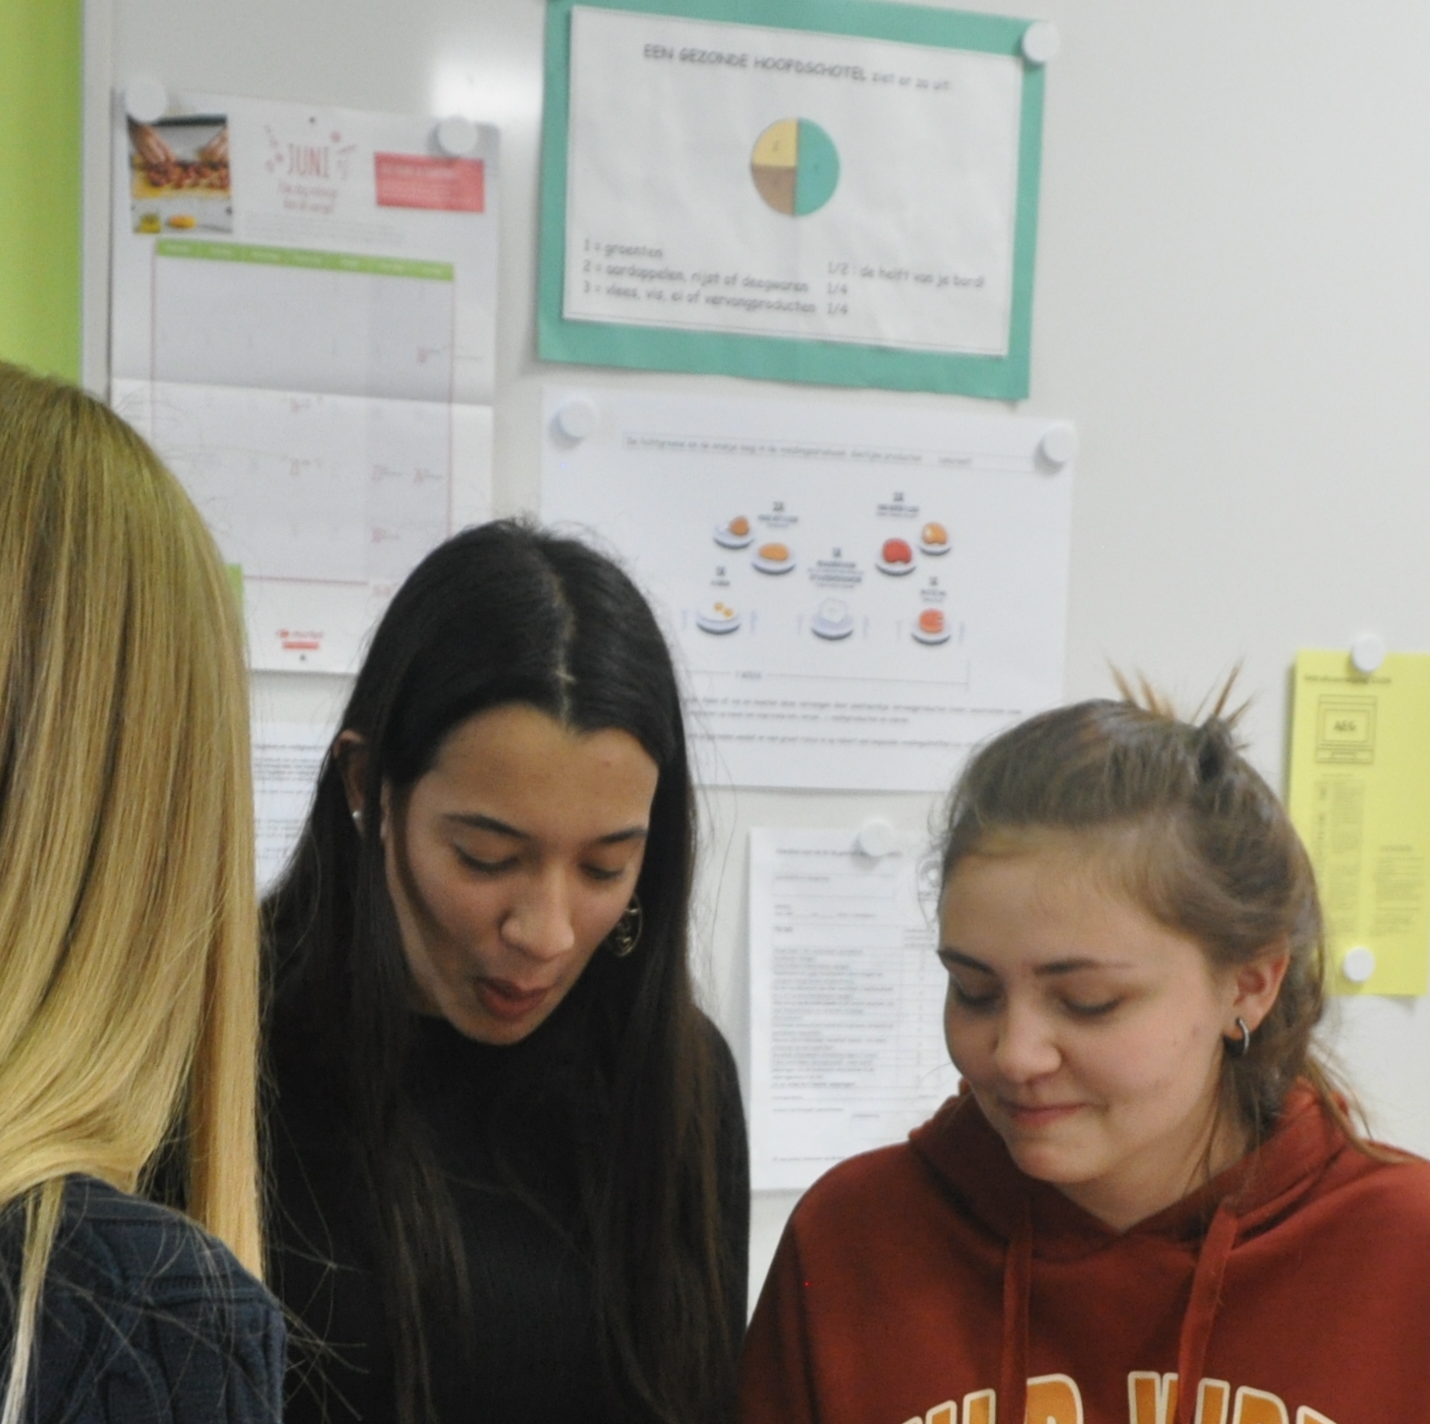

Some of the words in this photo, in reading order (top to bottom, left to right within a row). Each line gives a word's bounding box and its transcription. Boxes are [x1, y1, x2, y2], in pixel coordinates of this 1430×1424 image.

[643, 43, 675, 61] EEN
[679, 46, 749, 69] GEZONDE
[753, 55, 867, 82] HOOFDSCHOTEL
[604, 244, 663, 259] groenten
[690, 270, 720, 287] rijst
